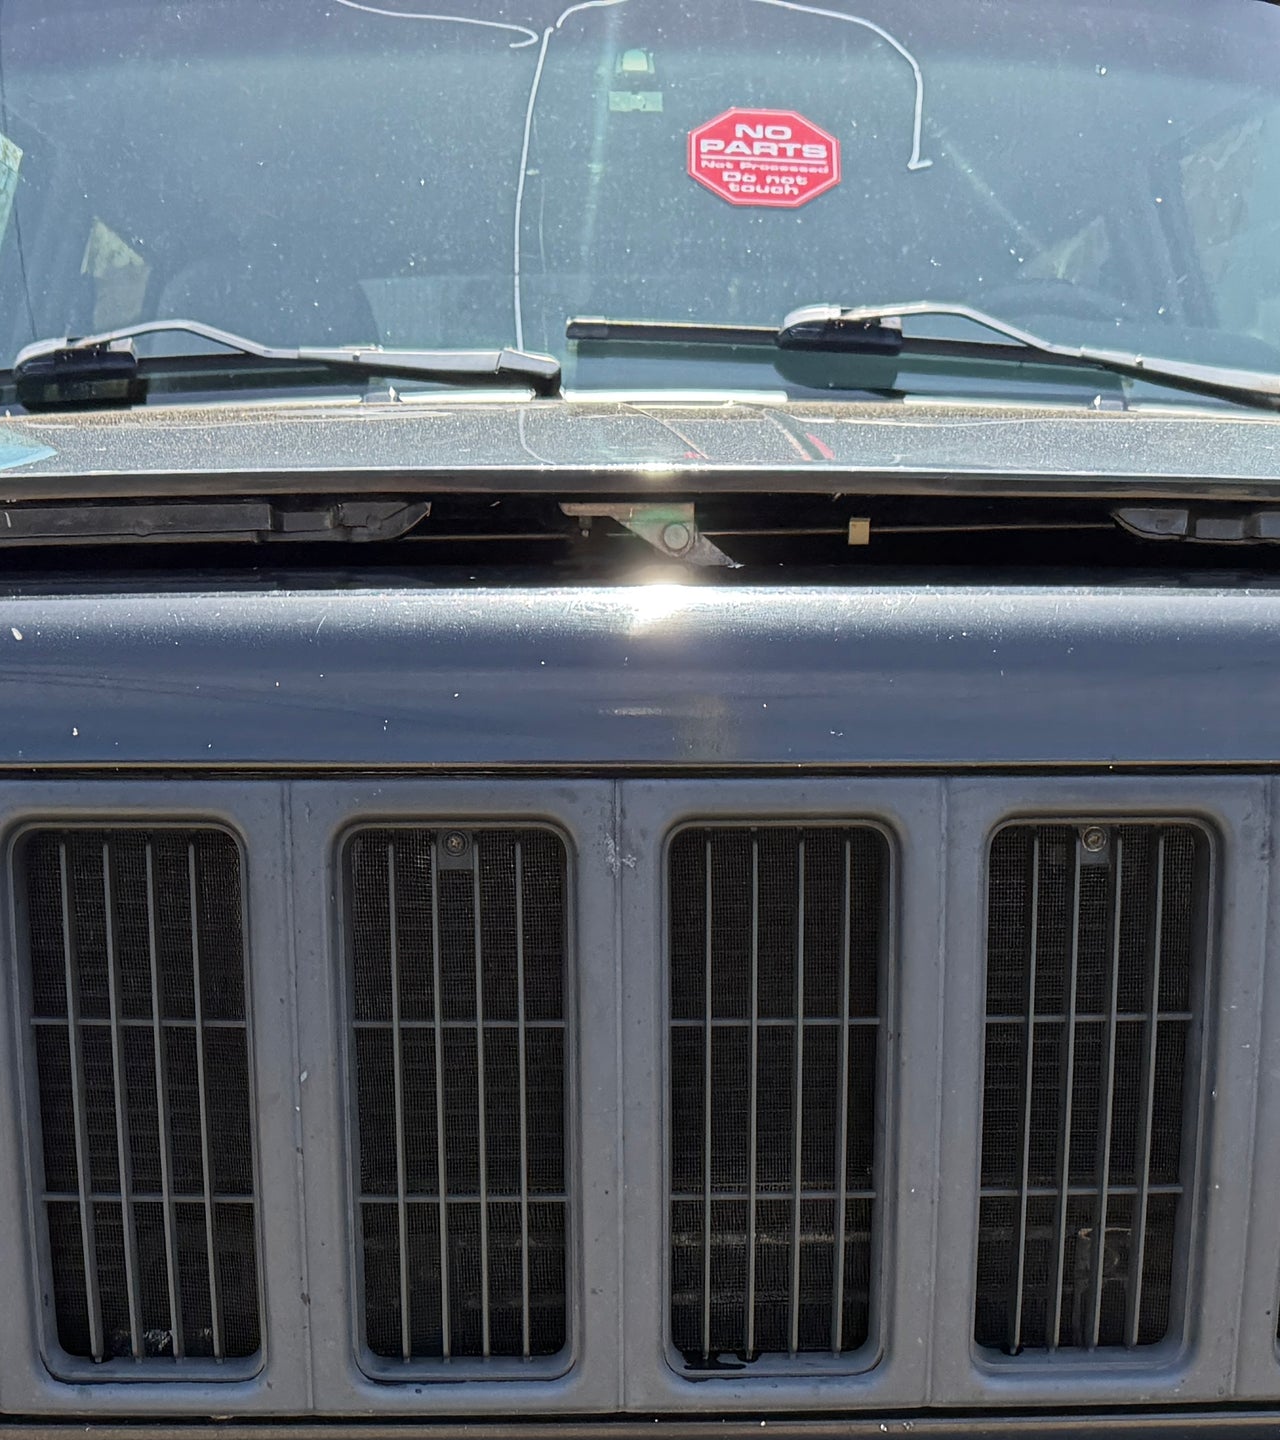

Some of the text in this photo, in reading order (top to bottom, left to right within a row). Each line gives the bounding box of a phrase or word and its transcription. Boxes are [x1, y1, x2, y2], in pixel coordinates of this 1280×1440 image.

[735, 123, 792, 140] NO
[700, 139, 827, 159] PARTS
[701, 159, 734, 170] Not
[722, 171, 808, 186] Do not
[729, 182, 799, 196] touch
